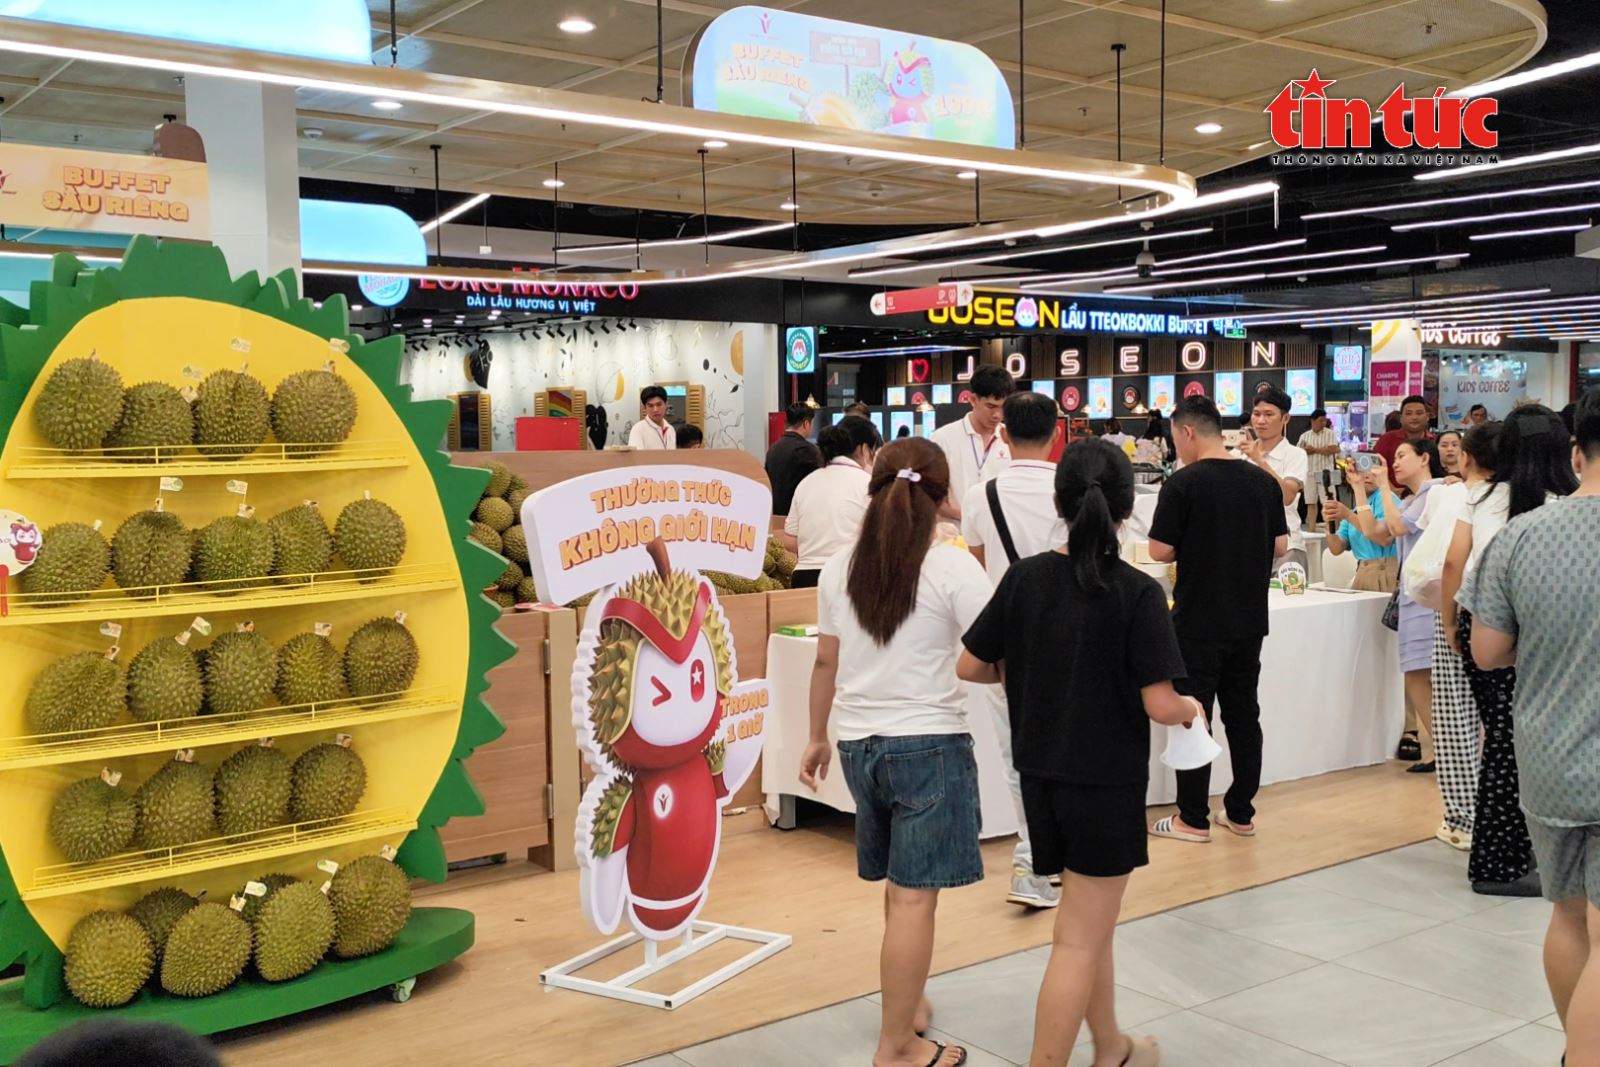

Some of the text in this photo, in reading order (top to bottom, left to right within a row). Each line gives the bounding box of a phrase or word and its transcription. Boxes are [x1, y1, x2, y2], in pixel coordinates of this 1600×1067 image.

[63, 166, 171, 193] BUFFET
[42, 185, 189, 222] SẦU RIÊNG
[515, 298, 555, 310] HƯƠNG
[558, 301, 570, 313] VỊ
[573, 299, 596, 313] VIỆT
[1089, 311, 1164, 332] TTEOKBOKKI
[1421, 322, 1444, 344] IDS
[1457, 380, 1510, 393] KIDS COFFEE
[682, 479, 732, 507] THỨC
[559, 509, 756, 570] KHÔNG GIỚI HẠN
[719, 687, 769, 719] TRONG
[727, 712, 764, 744] 1 GIỜ
